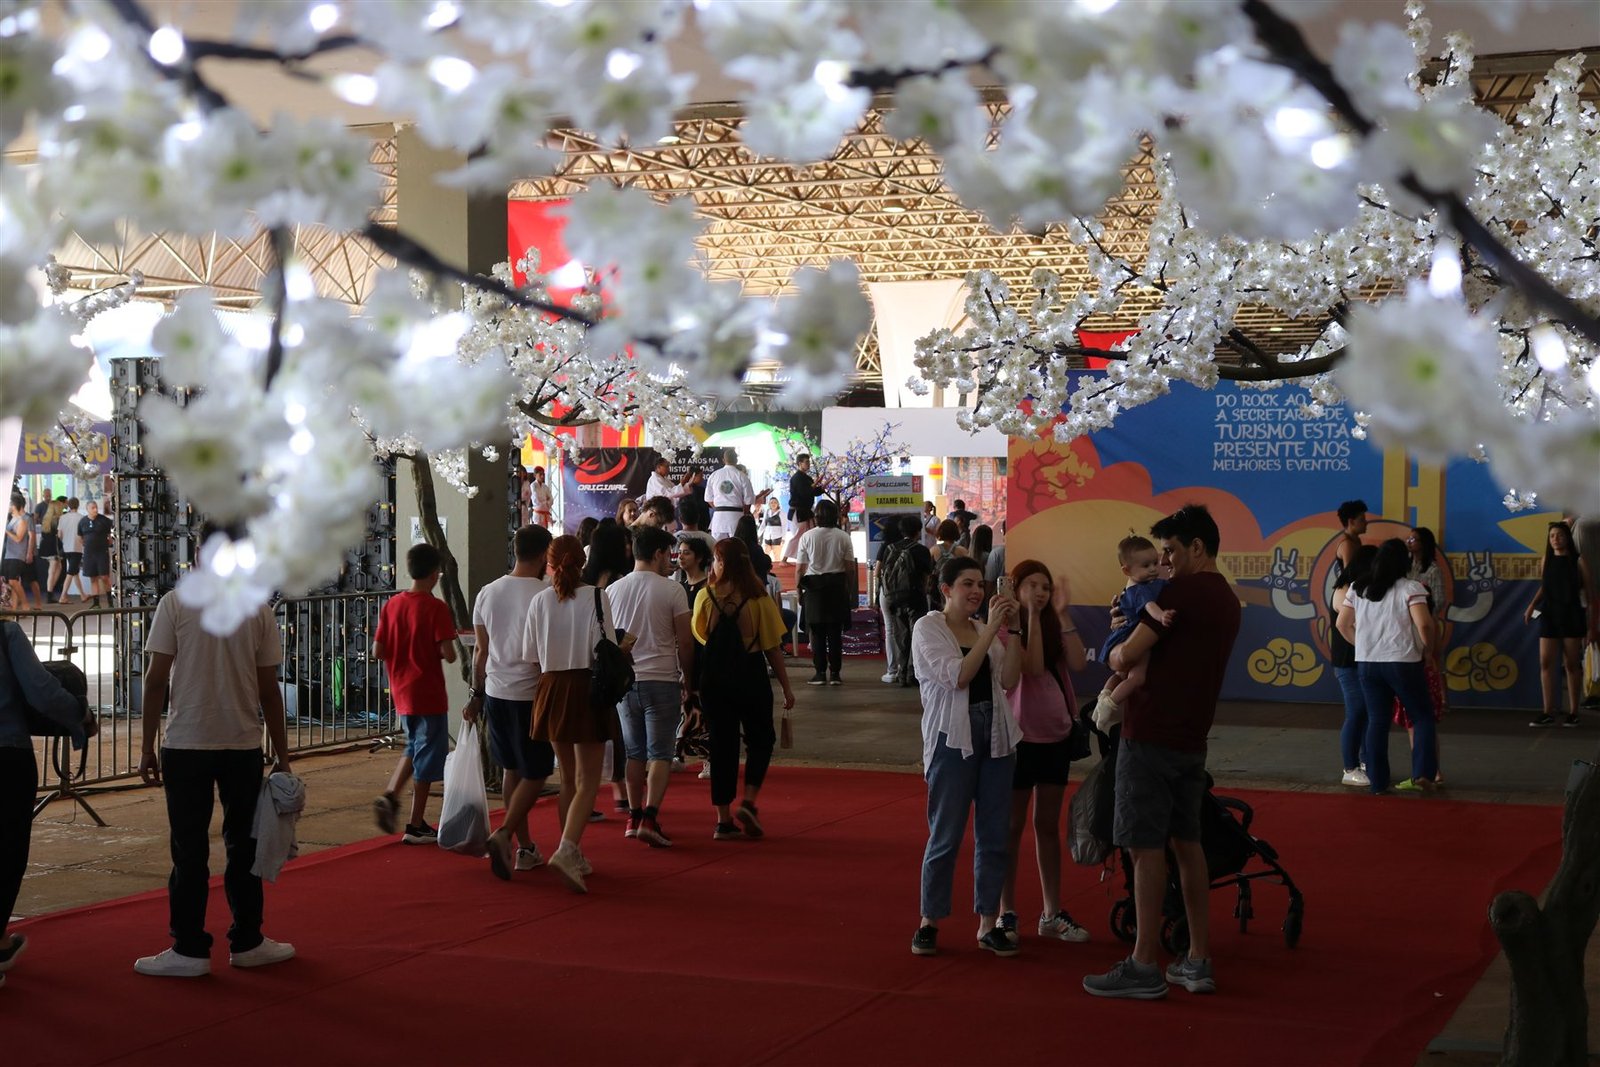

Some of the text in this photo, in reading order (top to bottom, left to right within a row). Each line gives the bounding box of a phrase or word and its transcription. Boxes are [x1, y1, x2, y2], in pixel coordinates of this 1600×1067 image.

[1216, 394, 1237, 407] DO
[1242, 394, 1279, 407] ROCK
[1284, 394, 1306, 407] AO
[1215, 409, 1227, 421] A
[1232, 408, 1320, 421] SECRETAR
[1215, 417, 1349, 439] TURISMO ESTÁ
[1214, 441, 1350, 457] PRESENTE NOS
[1213, 459, 1351, 471] MELHORES EVENTOS.
